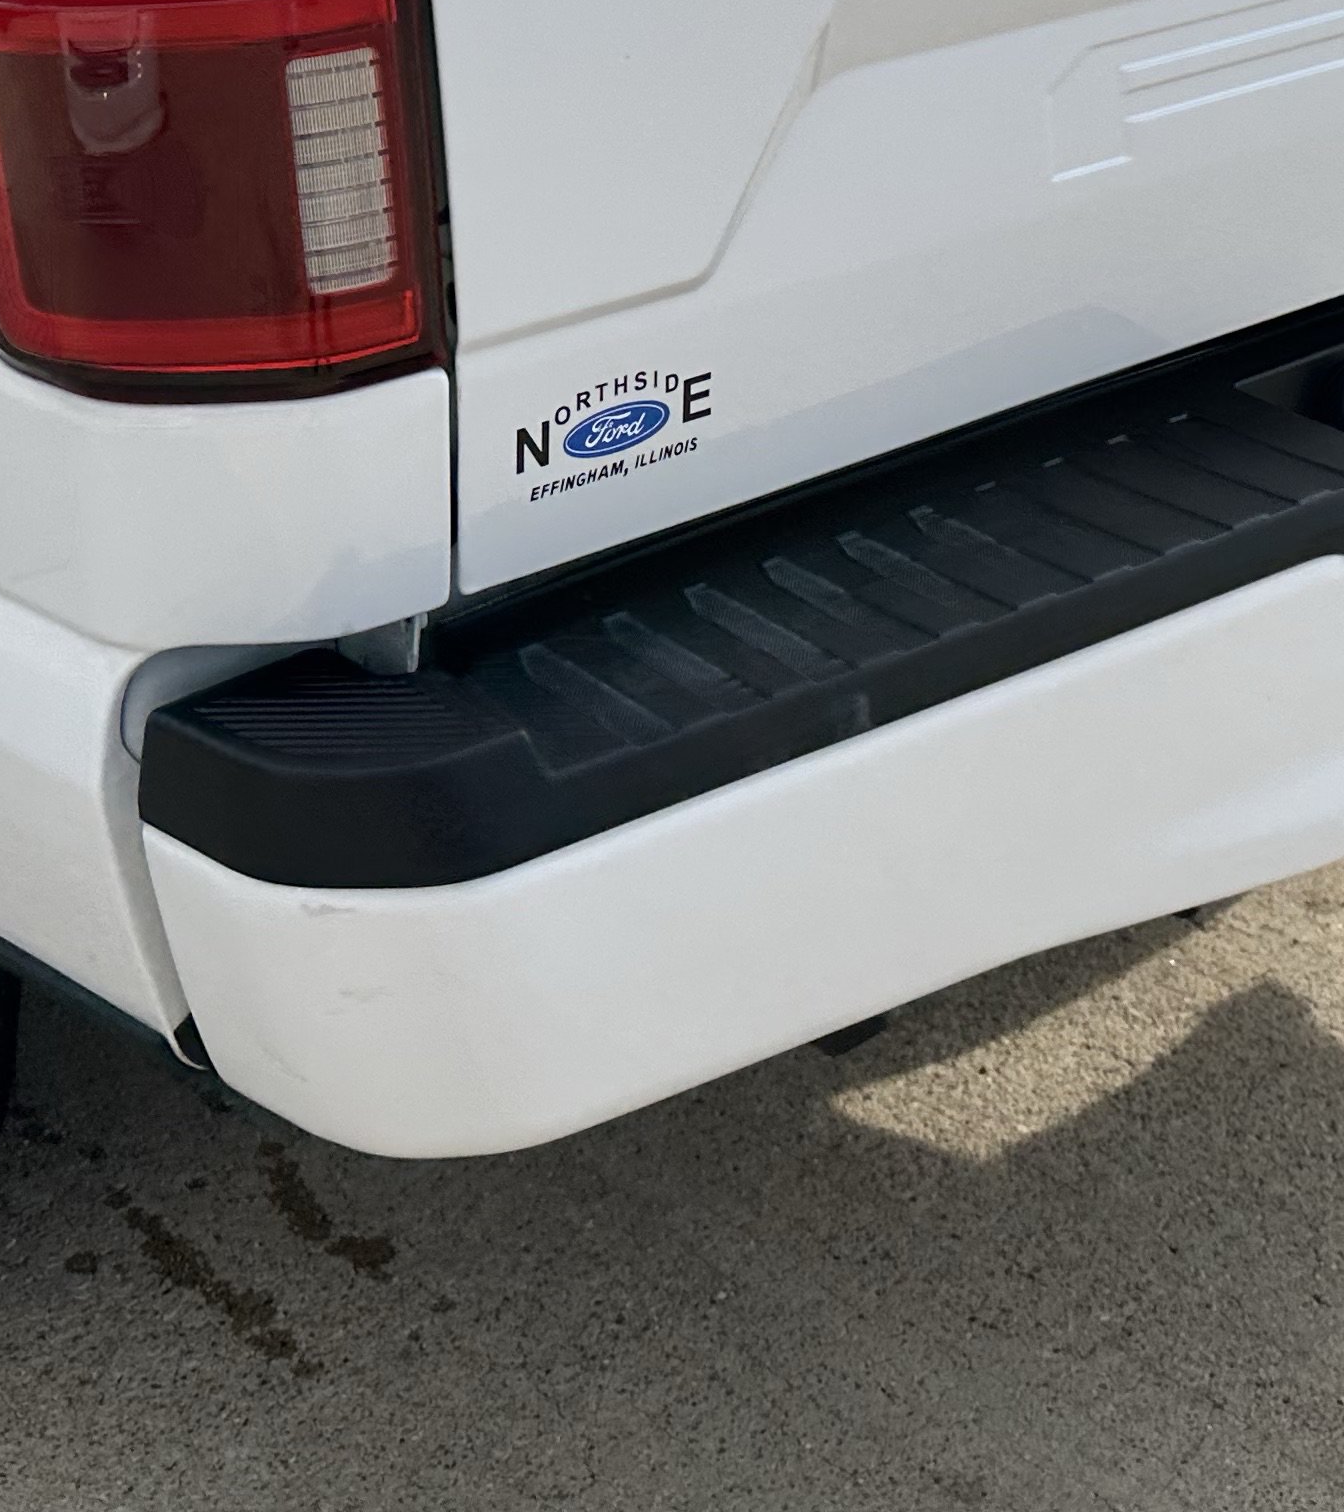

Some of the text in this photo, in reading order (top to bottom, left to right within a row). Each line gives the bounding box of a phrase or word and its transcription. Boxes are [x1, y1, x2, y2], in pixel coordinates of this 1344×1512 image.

[516, 370, 713, 475] NORTHSIDE
[584, 410, 647, 449] Ford
[529, 437, 699, 503] EFFINGHAM, ILLINOIS
